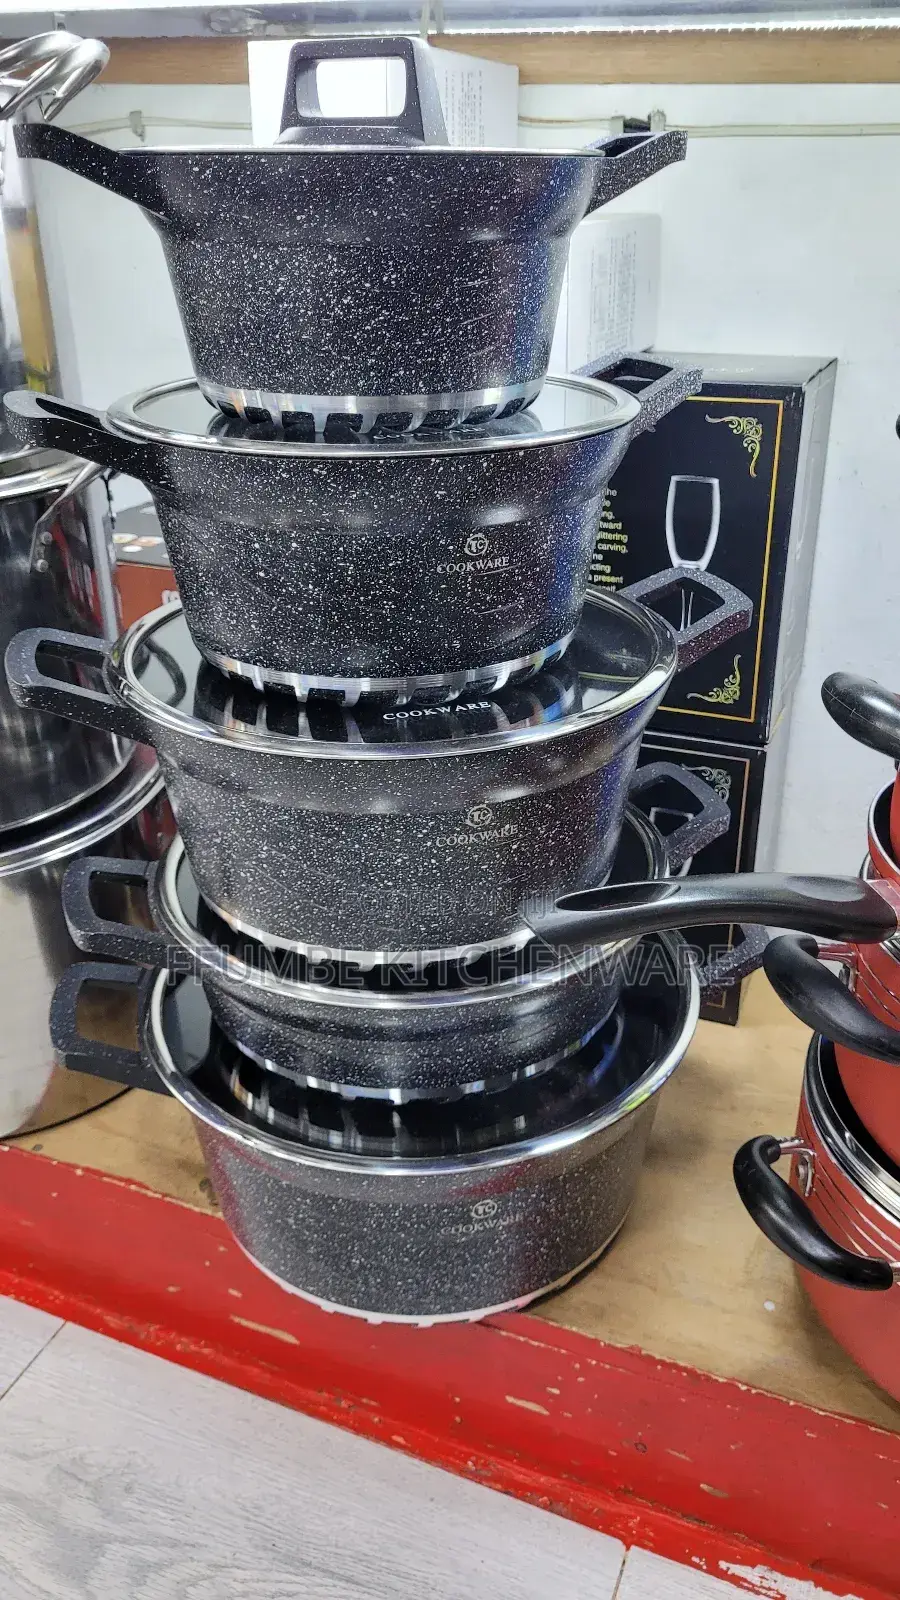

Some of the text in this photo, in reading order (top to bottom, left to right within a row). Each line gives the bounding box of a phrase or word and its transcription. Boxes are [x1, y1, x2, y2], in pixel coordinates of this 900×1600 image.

[436, 556, 510, 574] COOKWARE
[594, 574, 624, 584] present
[383, 701, 492, 720] COOKWARE
[435, 824, 519, 847] COOKWARE
